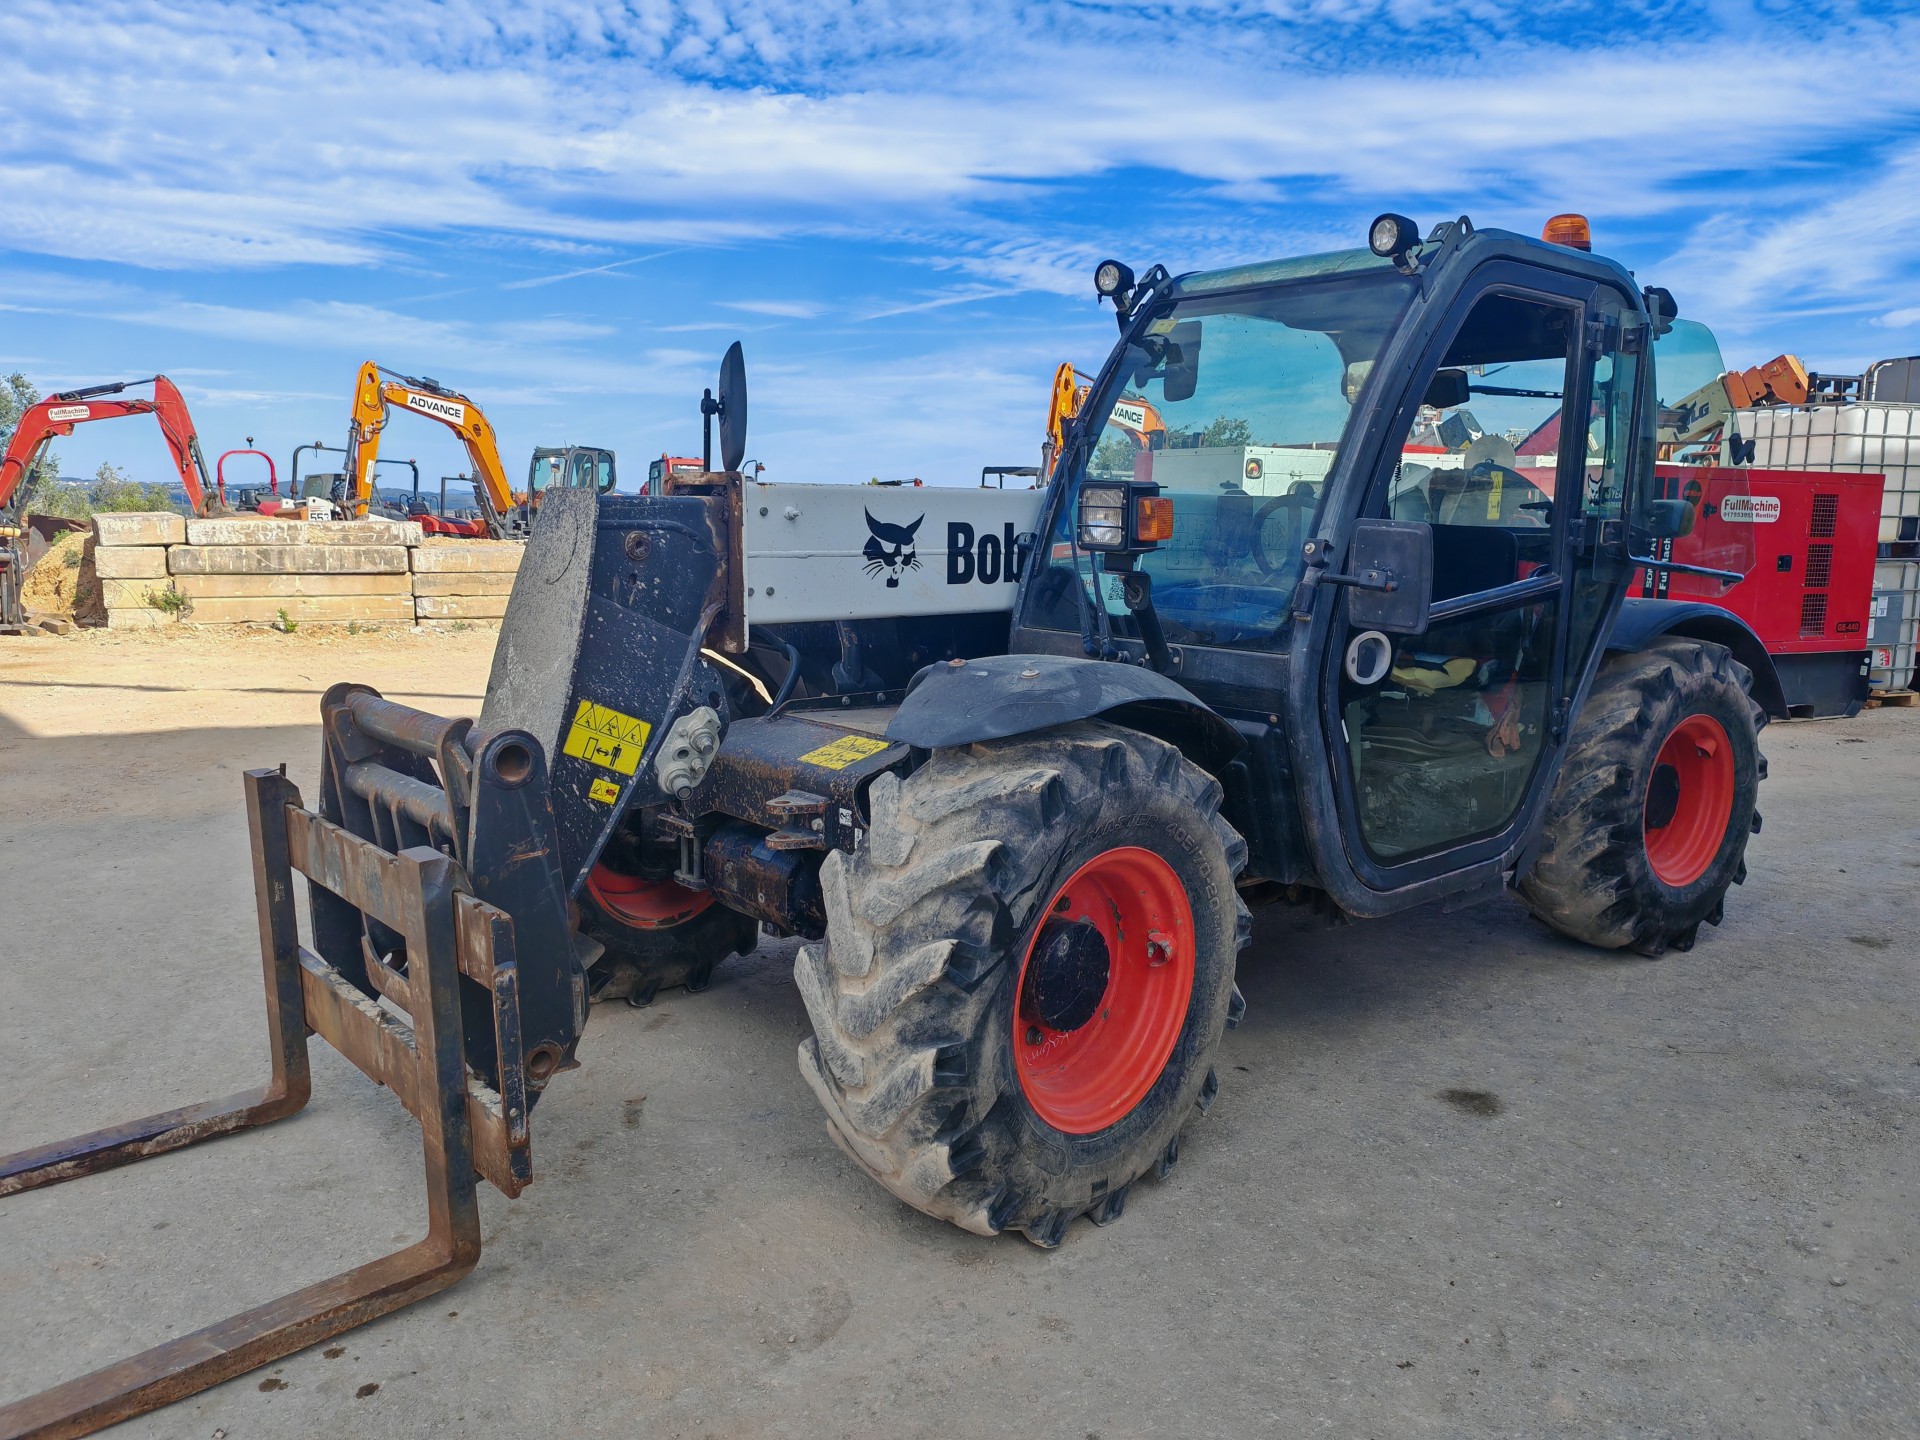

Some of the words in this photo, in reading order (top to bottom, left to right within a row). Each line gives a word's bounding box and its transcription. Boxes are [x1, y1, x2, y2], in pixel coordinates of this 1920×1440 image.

[410, 396, 461, 418] ADVANCE
[1724, 499, 1779, 512] FullMachine
[1755, 512, 1778, 520] Renting
